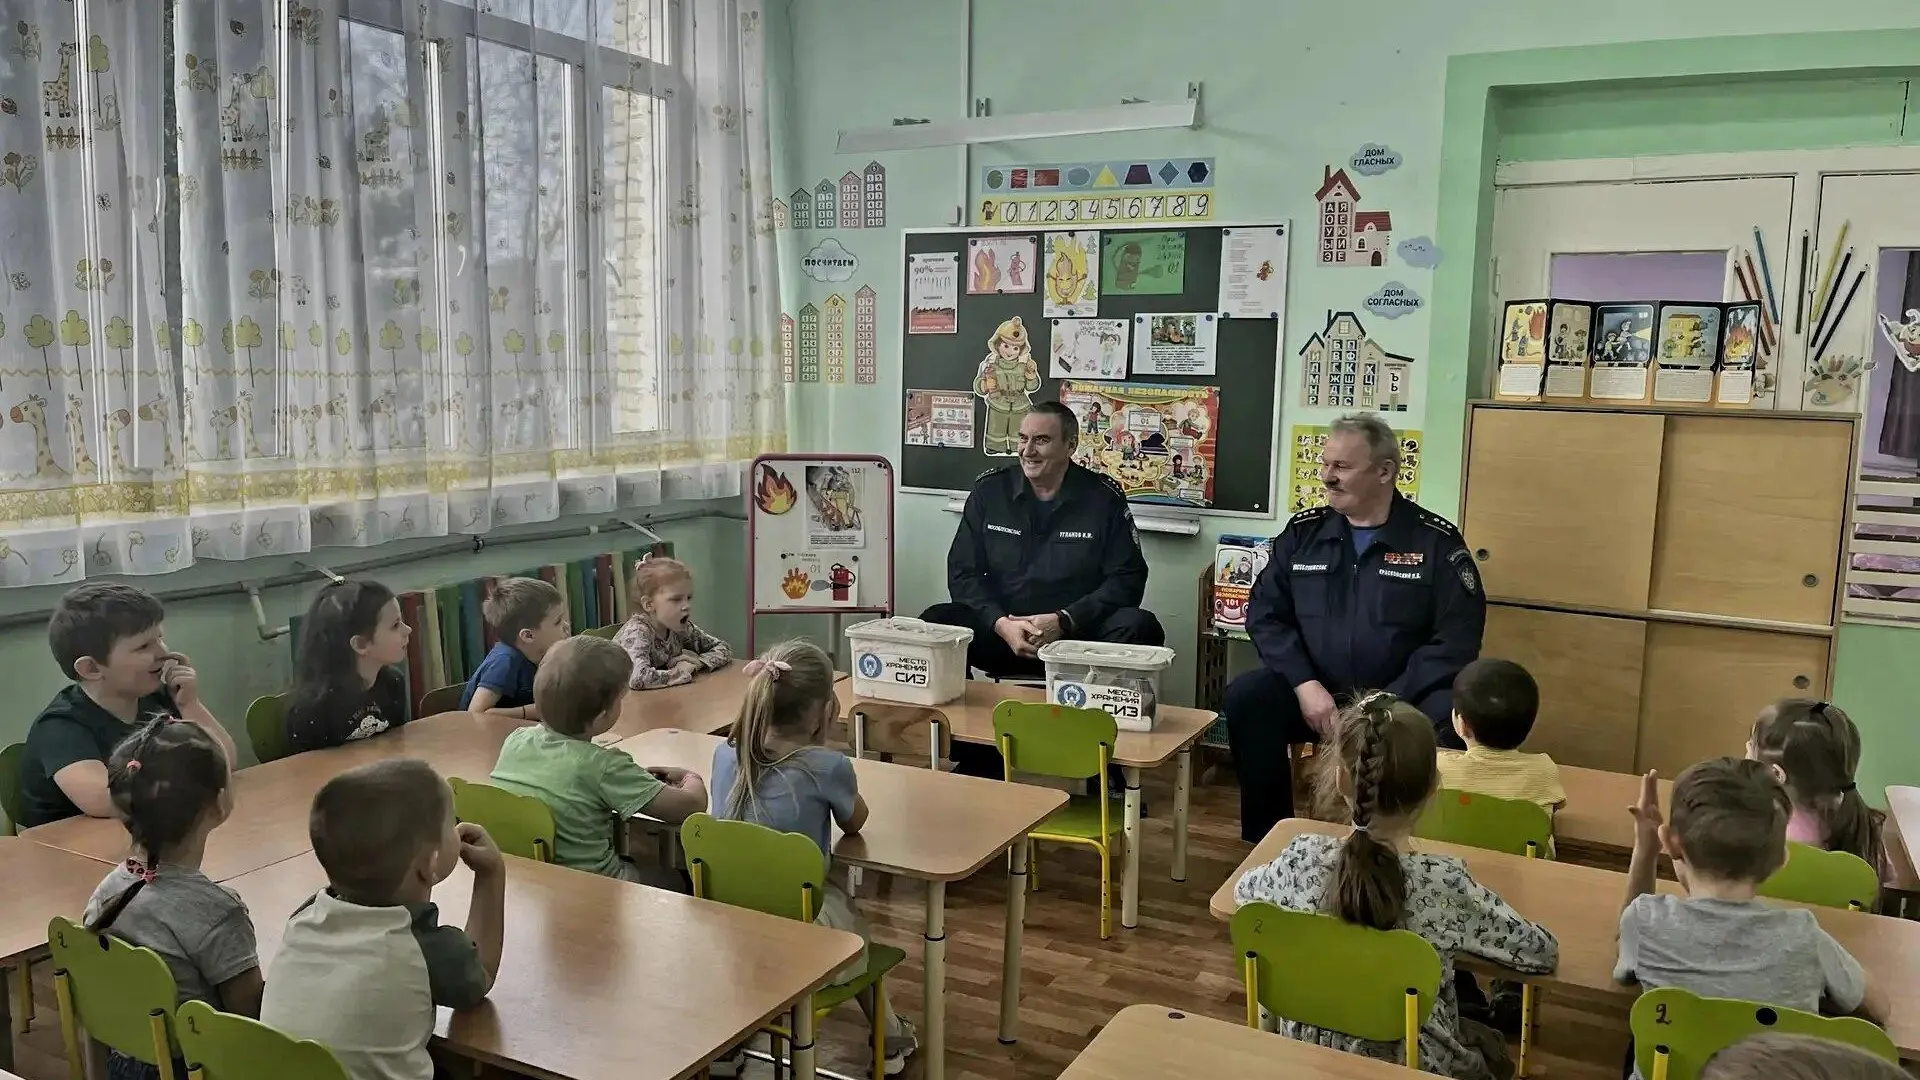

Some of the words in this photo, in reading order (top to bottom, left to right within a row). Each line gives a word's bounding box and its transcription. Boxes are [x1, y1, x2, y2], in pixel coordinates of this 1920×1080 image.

[1364, 148, 1385, 157] ДОМ
[1354, 157, 1395, 166] ГЛАСНЫХ
[1006, 201, 1018, 222] 0
[1027, 201, 1038, 219] 1
[1044, 200, 1058, 221] 2
[1064, 199, 1079, 220] 3
[1088, 199, 1099, 219] 4
[1105, 198, 1120, 219] 5
[1128, 197, 1142, 218] 6
[1149, 196, 1163, 218] 7
[1174, 195, 1186, 216] 8
[1195, 193, 1209, 217] 9
[1326, 203, 1334, 212] А
[1340, 203, 1348, 212] Я
[1326, 214, 1334, 224] О
[1326, 227, 1333, 236] У
[1338, 226, 1347, 236] Ю
[1324, 239, 1333, 249] Ы
[1338, 239, 1345, 249] И
[1324, 251, 1332, 261] Э
[1339, 251, 1345, 261] Е
[804, 258, 854, 267] ПОСЧИТАЕМ
[1383, 289, 1404, 298] ДОМ
[1367, 298, 1420, 307] СОГЛАСНЫХ
[1333, 340, 1341, 349] Б
[1347, 340, 1355, 349] П
[1333, 351, 1340, 360] В
[1346, 351, 1355, 360] Ф
[1311, 363, 1319, 372] Л
[1332, 363, 1339, 372] Г
[1346, 363, 1354, 372] К
[1366, 365, 1374, 375] Х
[1309, 374, 1319, 384] М
[1330, 374, 1340, 383] Ж
[1344, 374, 1354, 383] Ш
[1365, 375, 1373, 385] Ц
[1071, 383, 1124, 394] ПОЖАРНАЯ
[1128, 387, 1209, 399] БЕЗОПАСНОСТЬ
[1309, 385, 1317, 394] Н
[1330, 385, 1338, 395] Д
[1345, 386, 1352, 395] Т
[1364, 386, 1372, 396] Ч
[1309, 396, 1316, 405] Р
[1330, 396, 1337, 405] З
[1344, 397, 1352, 406] С
[1363, 397, 1373, 408] Щ
[1225, 598, 1239, 606] 101
[898, 657, 928, 666] МЕСТО
[885, 662, 928, 672] ХРАНЕНИЯ
[895, 671, 927, 684] СИЗ
[1107, 688, 1140, 698] МЕСТО
[1090, 692, 1140, 705] ХРАНЕНИЯ
[1101, 703, 1138, 717] СИЗ
[57, 931, 68, 949] 2
[1655, 1003, 1672, 1025] 2
[188, 1015, 200, 1035] 2
